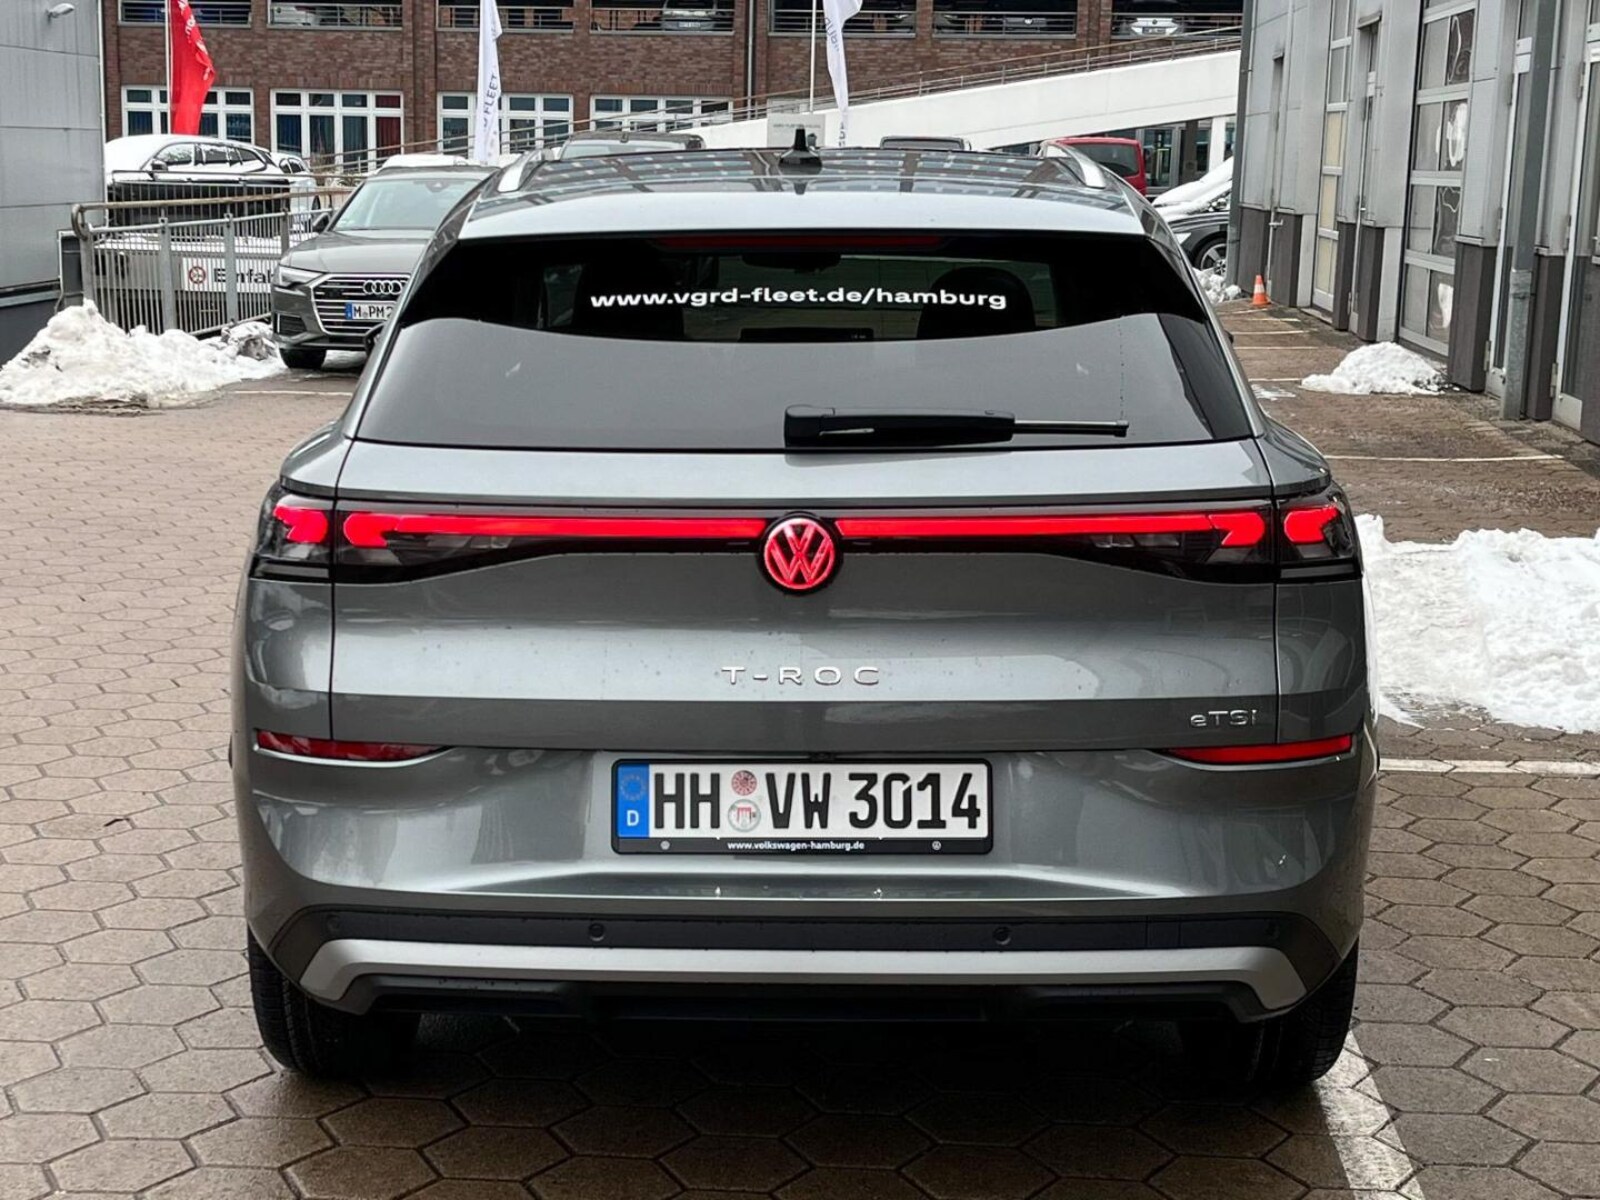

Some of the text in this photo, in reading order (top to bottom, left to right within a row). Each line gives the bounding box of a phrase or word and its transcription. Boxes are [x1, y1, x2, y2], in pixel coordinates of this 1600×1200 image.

[484, 75, 498, 116] FLEET
[590, 287, 1007, 310] www.vgrd-fleet.de/hamburg
[353, 305, 362, 318] M
[721, 666, 880, 686] T-ROC
[653, 772, 982, 830] HH VW 3014
[626, 809, 640, 827] D
[727, 841, 865, 851] www.volkswagen-hamburg.de
